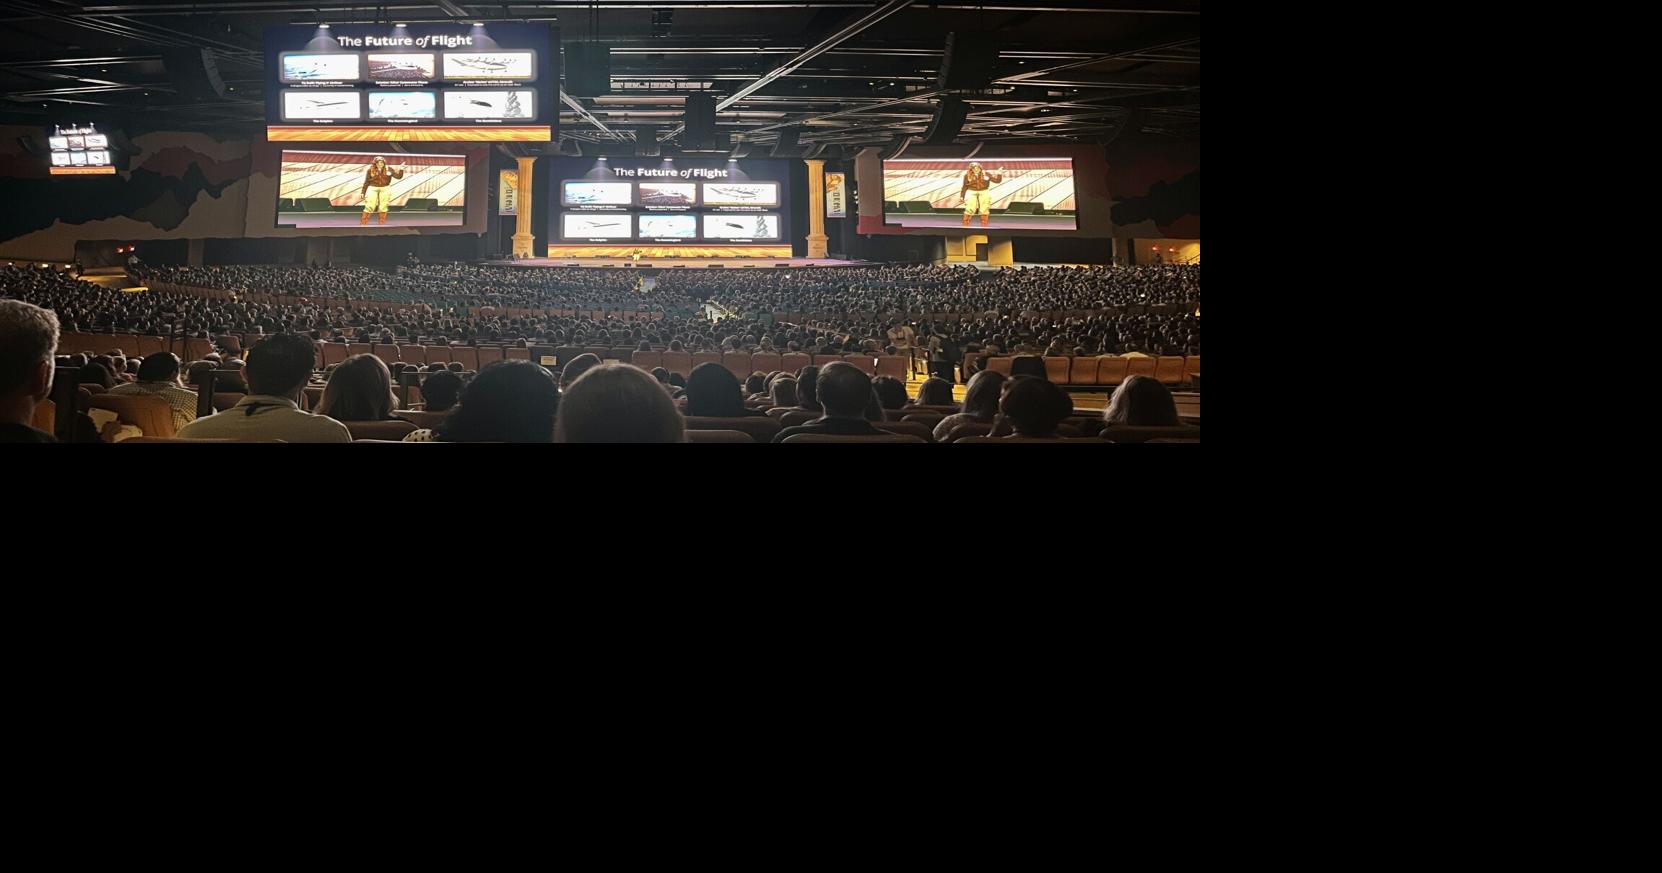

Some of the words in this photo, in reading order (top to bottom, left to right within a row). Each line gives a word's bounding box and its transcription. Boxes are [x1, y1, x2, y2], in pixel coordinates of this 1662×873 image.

[337, 36, 362, 46] The
[365, 36, 412, 46] Future
[416, 36, 430, 48] of
[432, 36, 472, 48] Flight
[614, 168, 634, 176] The
[638, 168, 678, 176] Future
[680, 168, 693, 178] of
[694, 168, 728, 178] Flight
